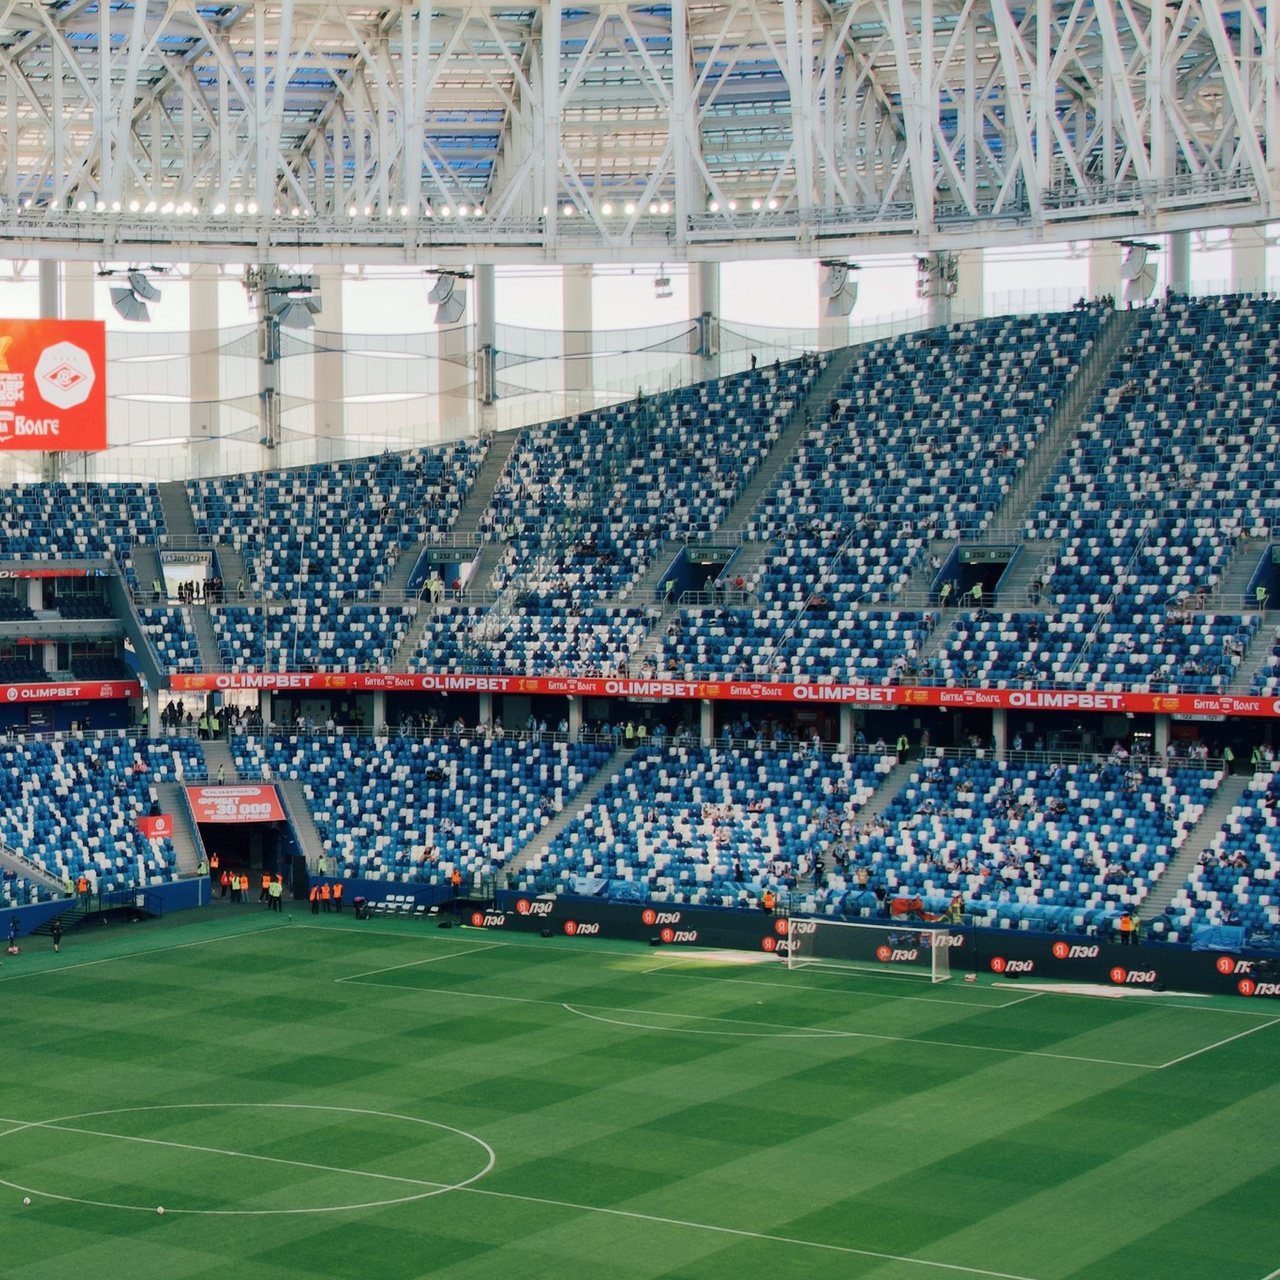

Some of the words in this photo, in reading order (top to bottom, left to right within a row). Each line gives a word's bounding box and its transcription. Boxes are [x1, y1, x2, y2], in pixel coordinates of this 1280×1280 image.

[216, 675, 313, 688] OLIMPBET
[422, 677, 509, 691] OLIMPBET
[21, 688, 81, 699] OLIMPBET
[605, 681, 698, 697] OLIMPBET
[793, 685, 896, 702] OLIMPBET
[1008, 692, 1123, 709] OLIMPBET
[198, 797, 240, 805] ФРИБЕТ
[216, 804, 238, 814] 30
[239, 803, 272, 814] 000
